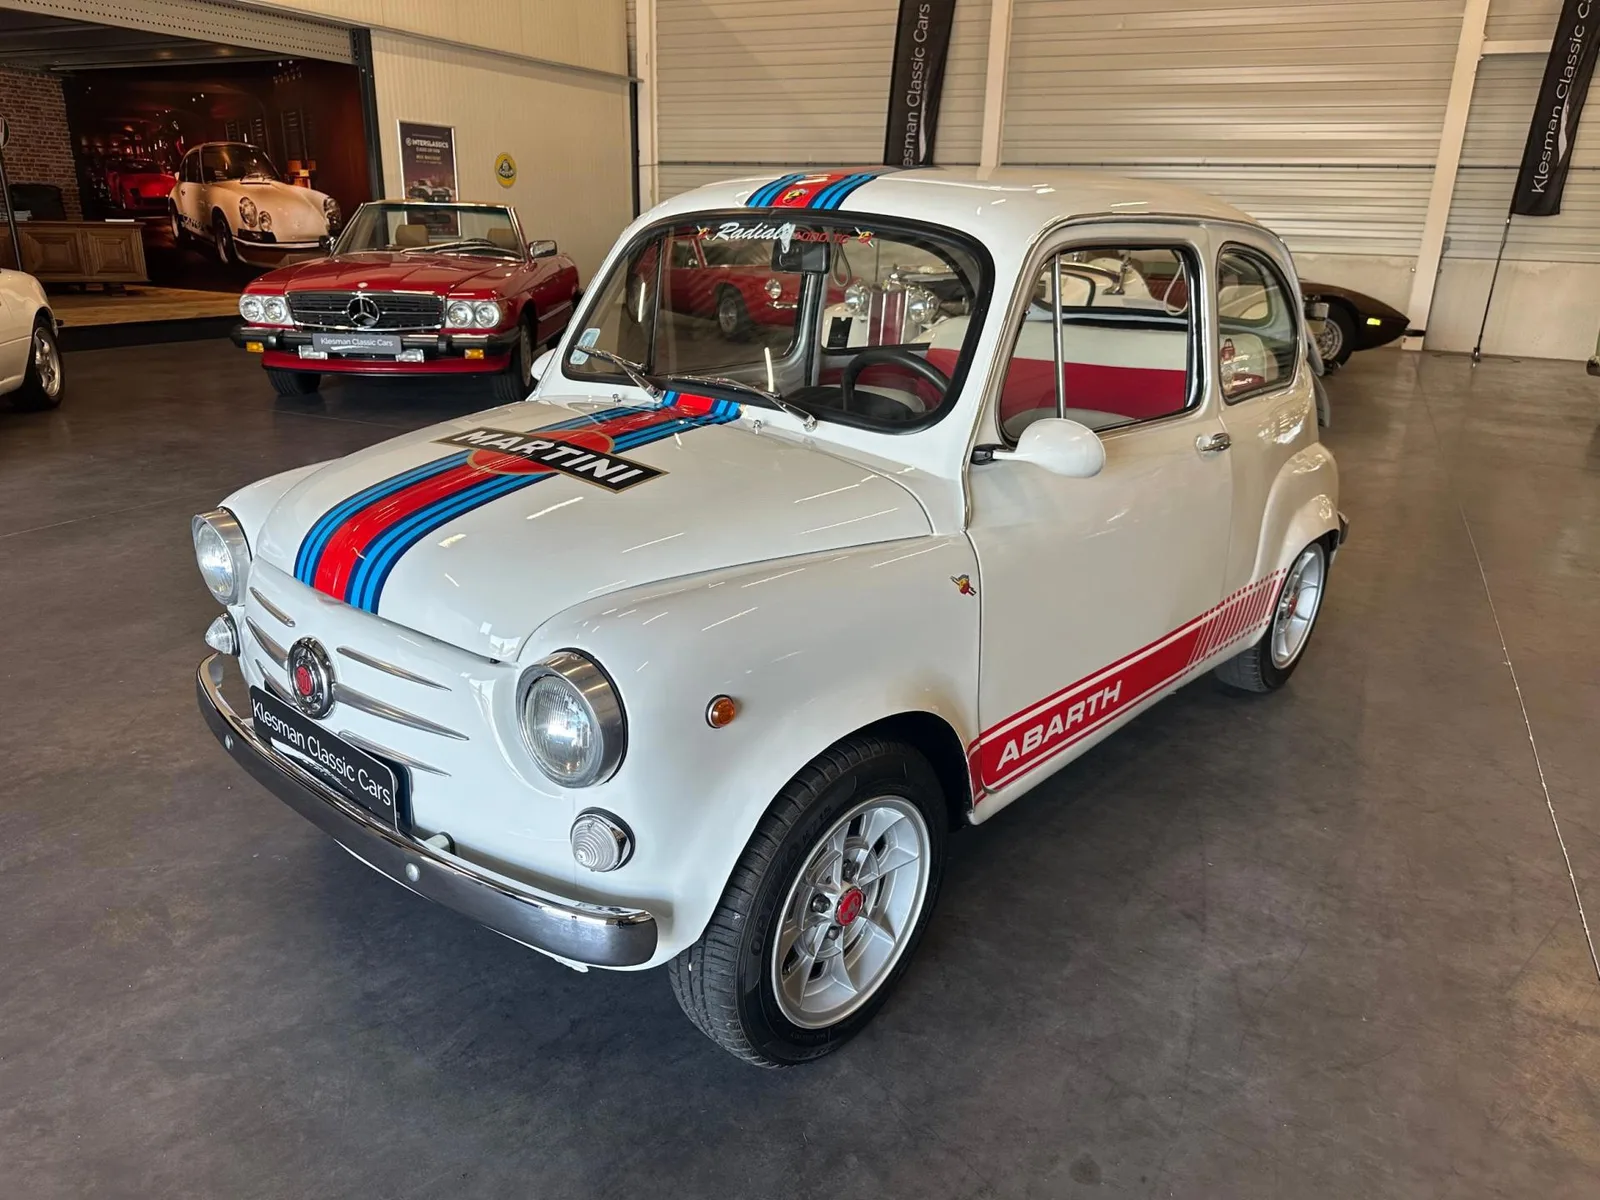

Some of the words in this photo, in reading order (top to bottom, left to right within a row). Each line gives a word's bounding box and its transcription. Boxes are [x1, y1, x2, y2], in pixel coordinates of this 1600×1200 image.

[913, 3, 931, 43] Cars
[906, 46, 925, 107] Classic
[1531, 105, 1562, 193] Klesman
[1556, 24, 1585, 99] Classic
[1577, 0, 1593, 19] C
[902, 112, 919, 166] esman
[320, 337, 352, 345] Klesman
[351, 338, 376, 346] Classic
[376, 338, 394, 347] Cars
[452, 430, 644, 484] MARTINI
[252, 698, 306, 750] Klesman
[307, 735, 356, 782] Classic
[357, 768, 392, 806] Cars
[996, 680, 1122, 772] ABARTH
